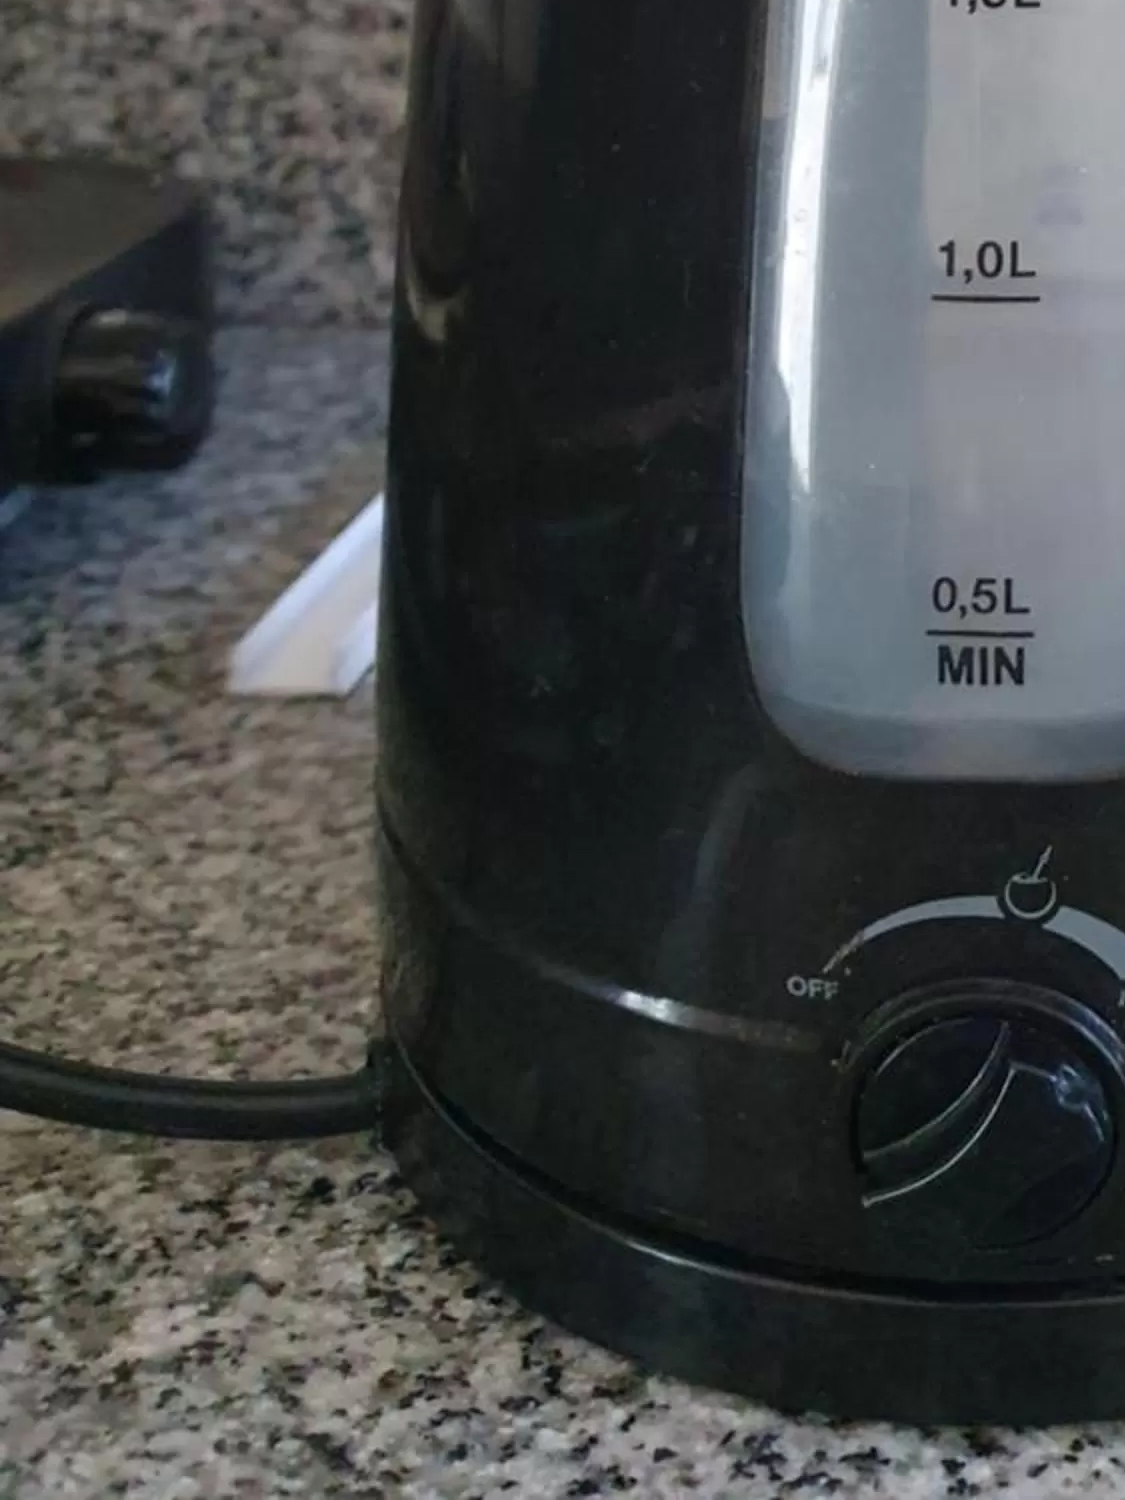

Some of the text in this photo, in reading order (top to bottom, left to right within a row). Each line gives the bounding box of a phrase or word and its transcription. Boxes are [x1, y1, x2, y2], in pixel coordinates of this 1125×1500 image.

[937, 239, 1038, 285] 1,0L
[931, 575, 1031, 620] 0,5L
[937, 644, 1025, 687] MIN
[786, 974, 839, 1000] OFF
